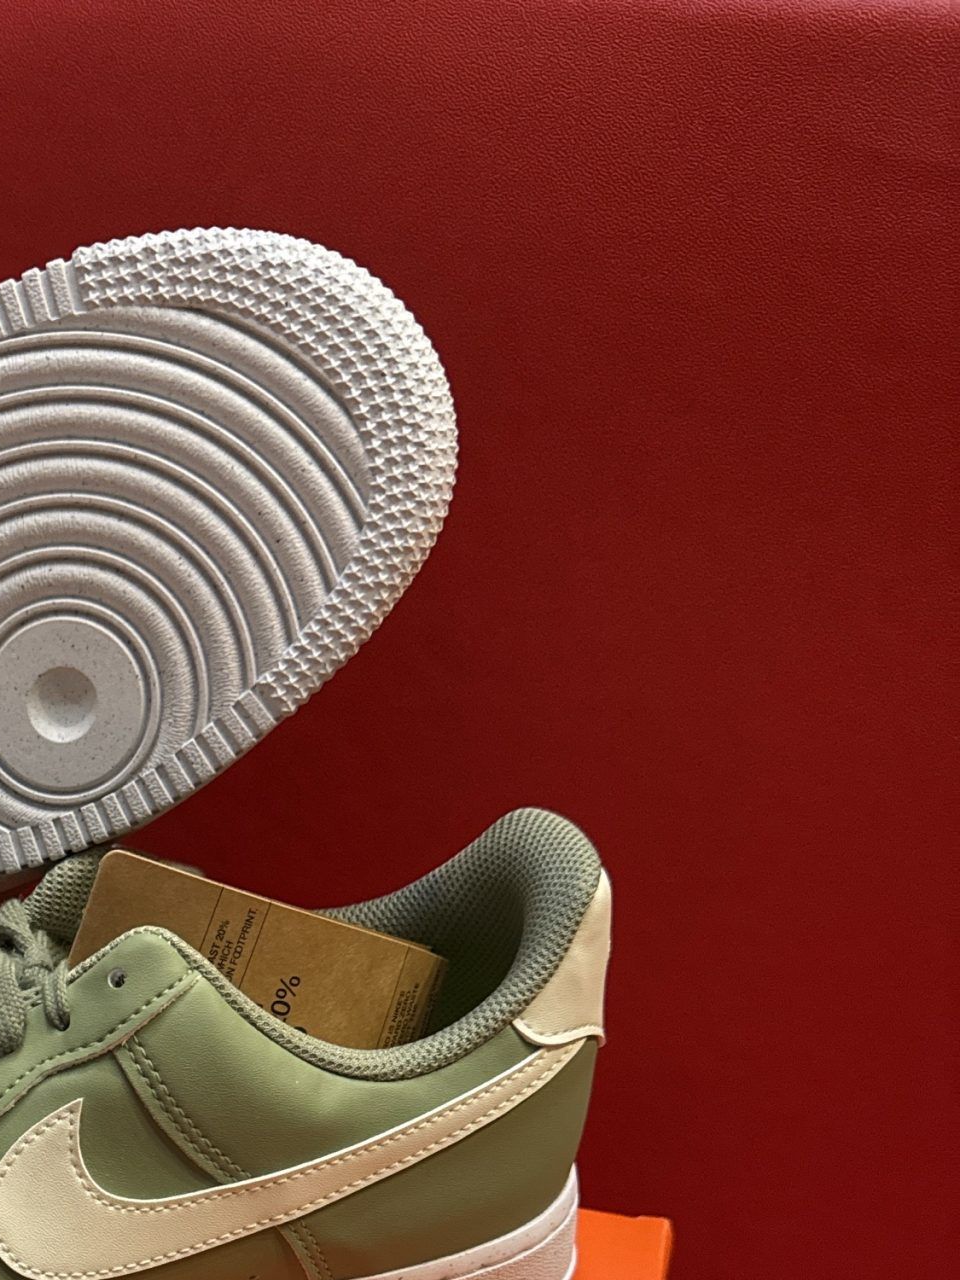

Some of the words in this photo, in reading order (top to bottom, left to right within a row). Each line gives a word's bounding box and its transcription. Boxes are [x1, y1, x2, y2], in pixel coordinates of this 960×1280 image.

[215, 920, 230, 942] 20%
[230, 907, 258, 966] FOOTPRINT.
[270, 975, 301, 1022] 0%
